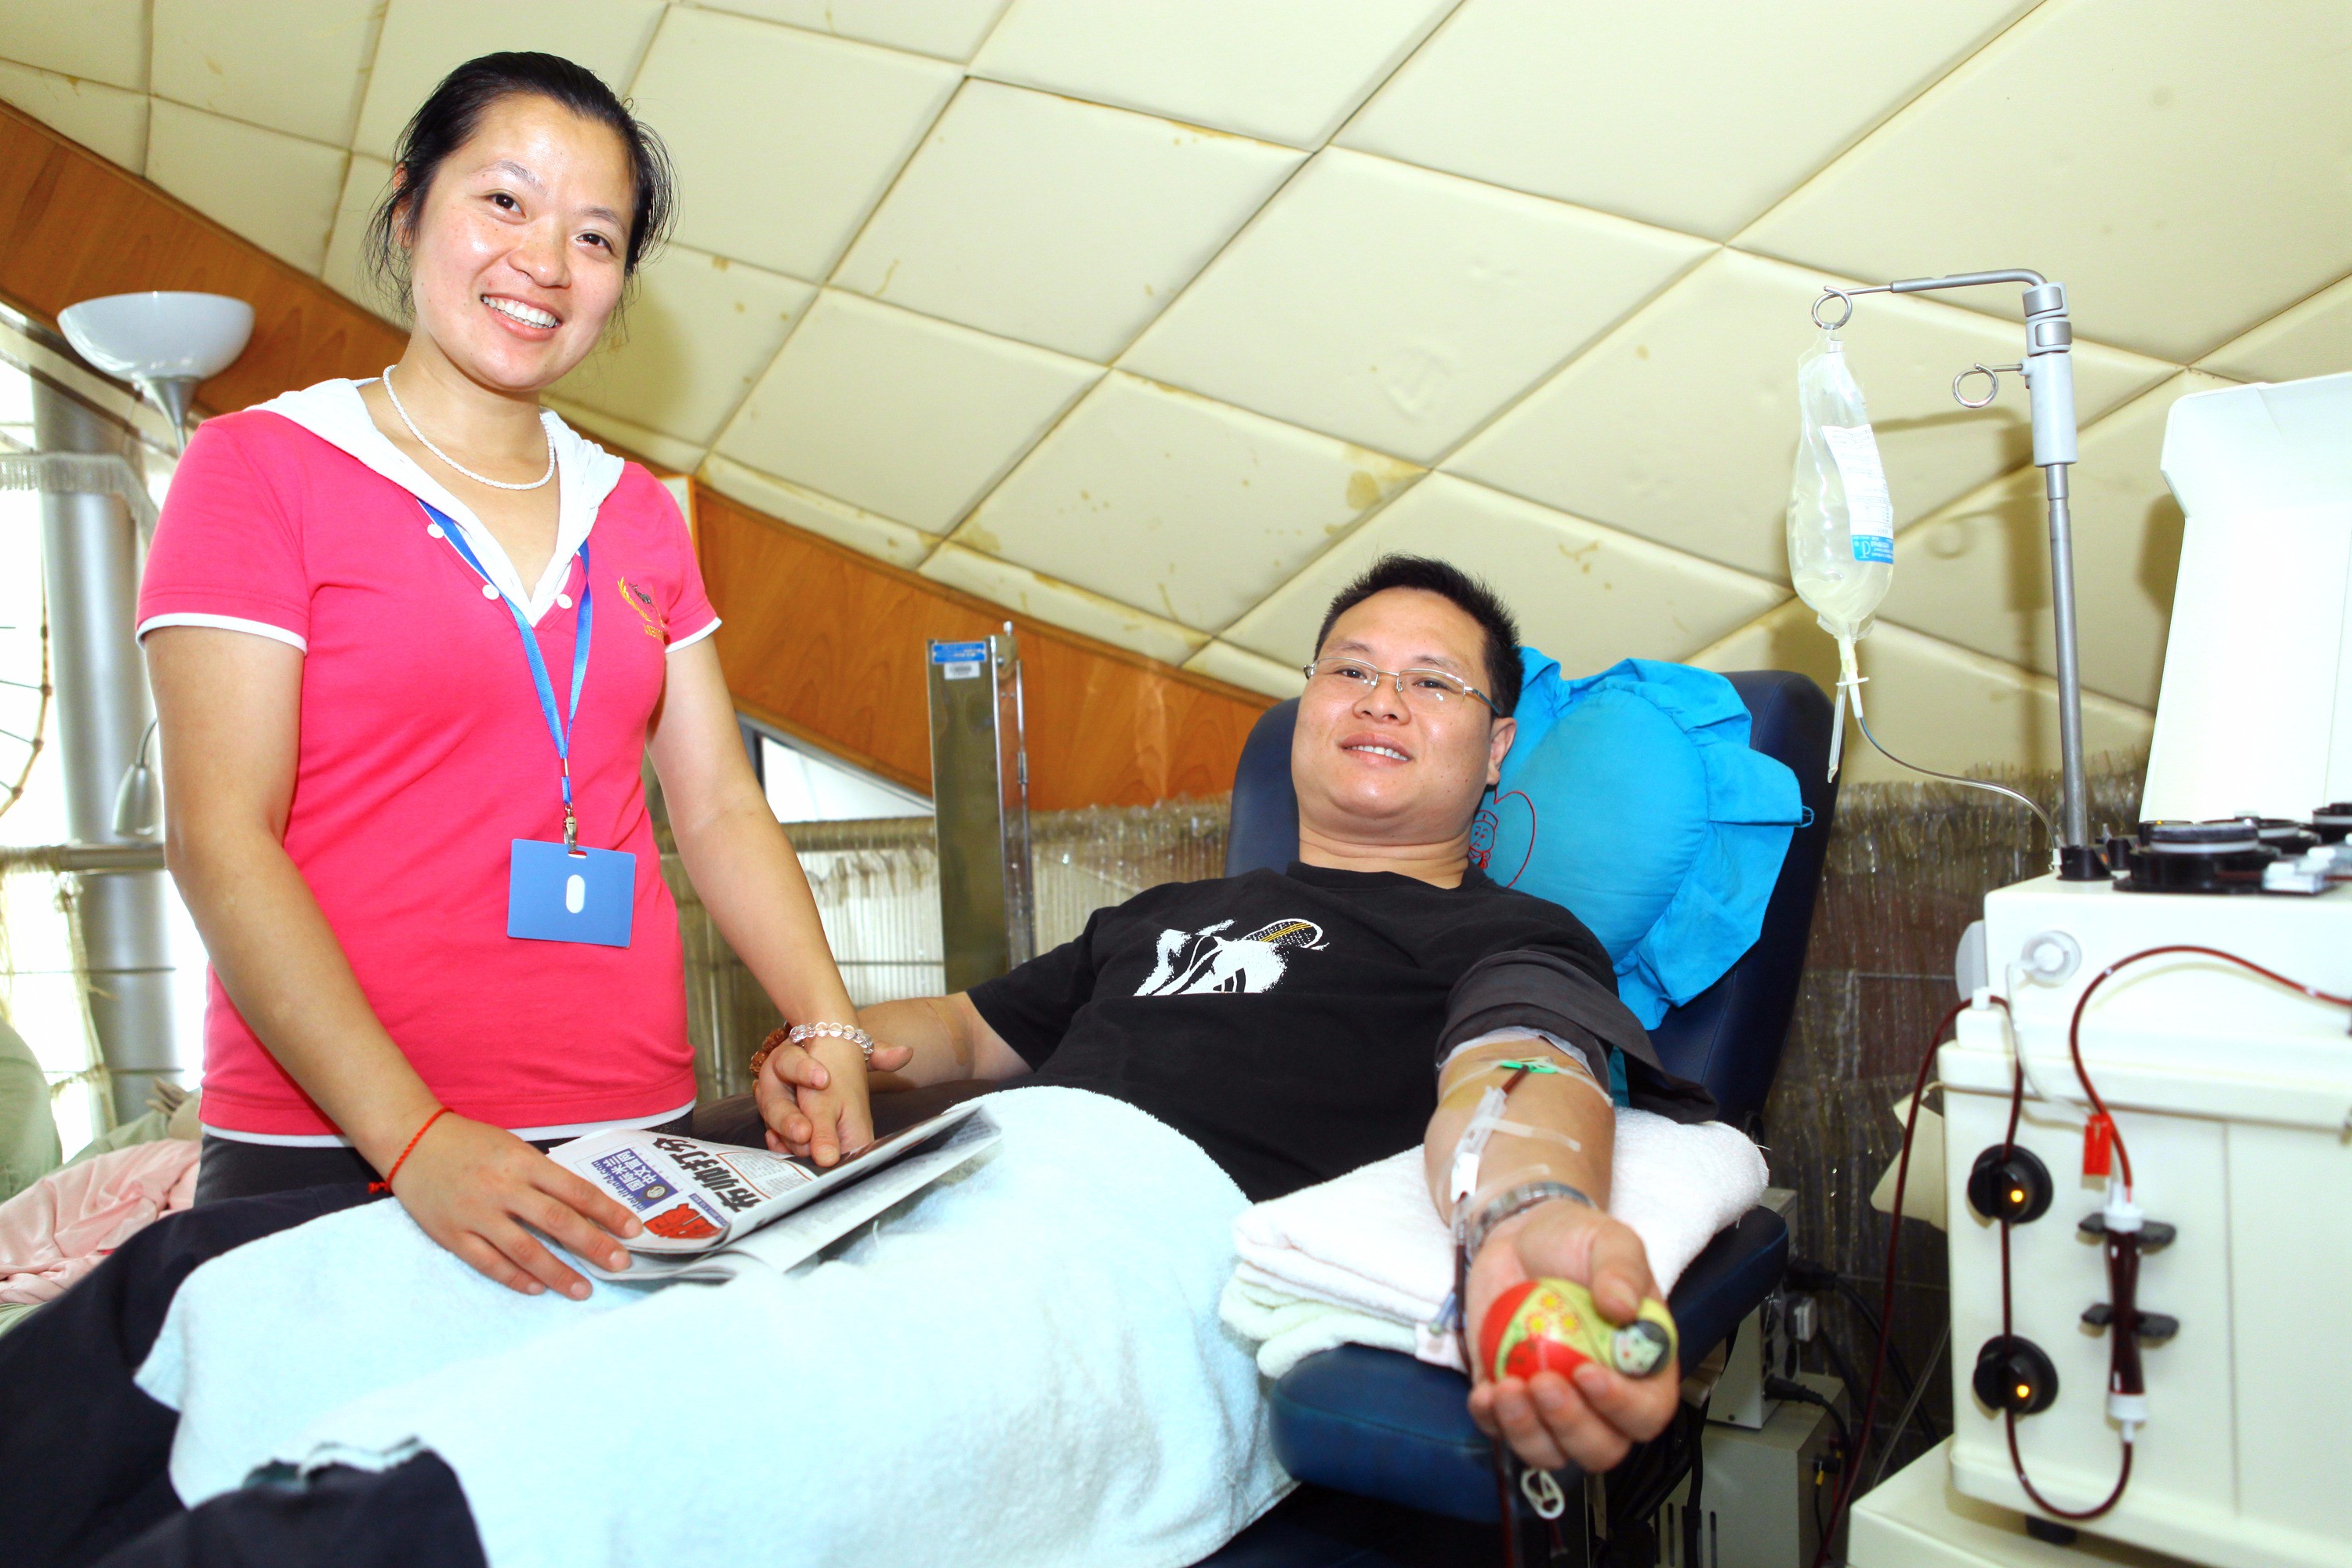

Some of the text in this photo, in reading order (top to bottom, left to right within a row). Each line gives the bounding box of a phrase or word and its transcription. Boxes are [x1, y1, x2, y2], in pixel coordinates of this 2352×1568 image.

[592, 1161, 645, 1213] inter.titan24.com
[603, 1156, 646, 1192] 国际米兰
[615, 1151, 657, 1185] 中文官网
[652, 1138, 762, 1213] 布帅打分
